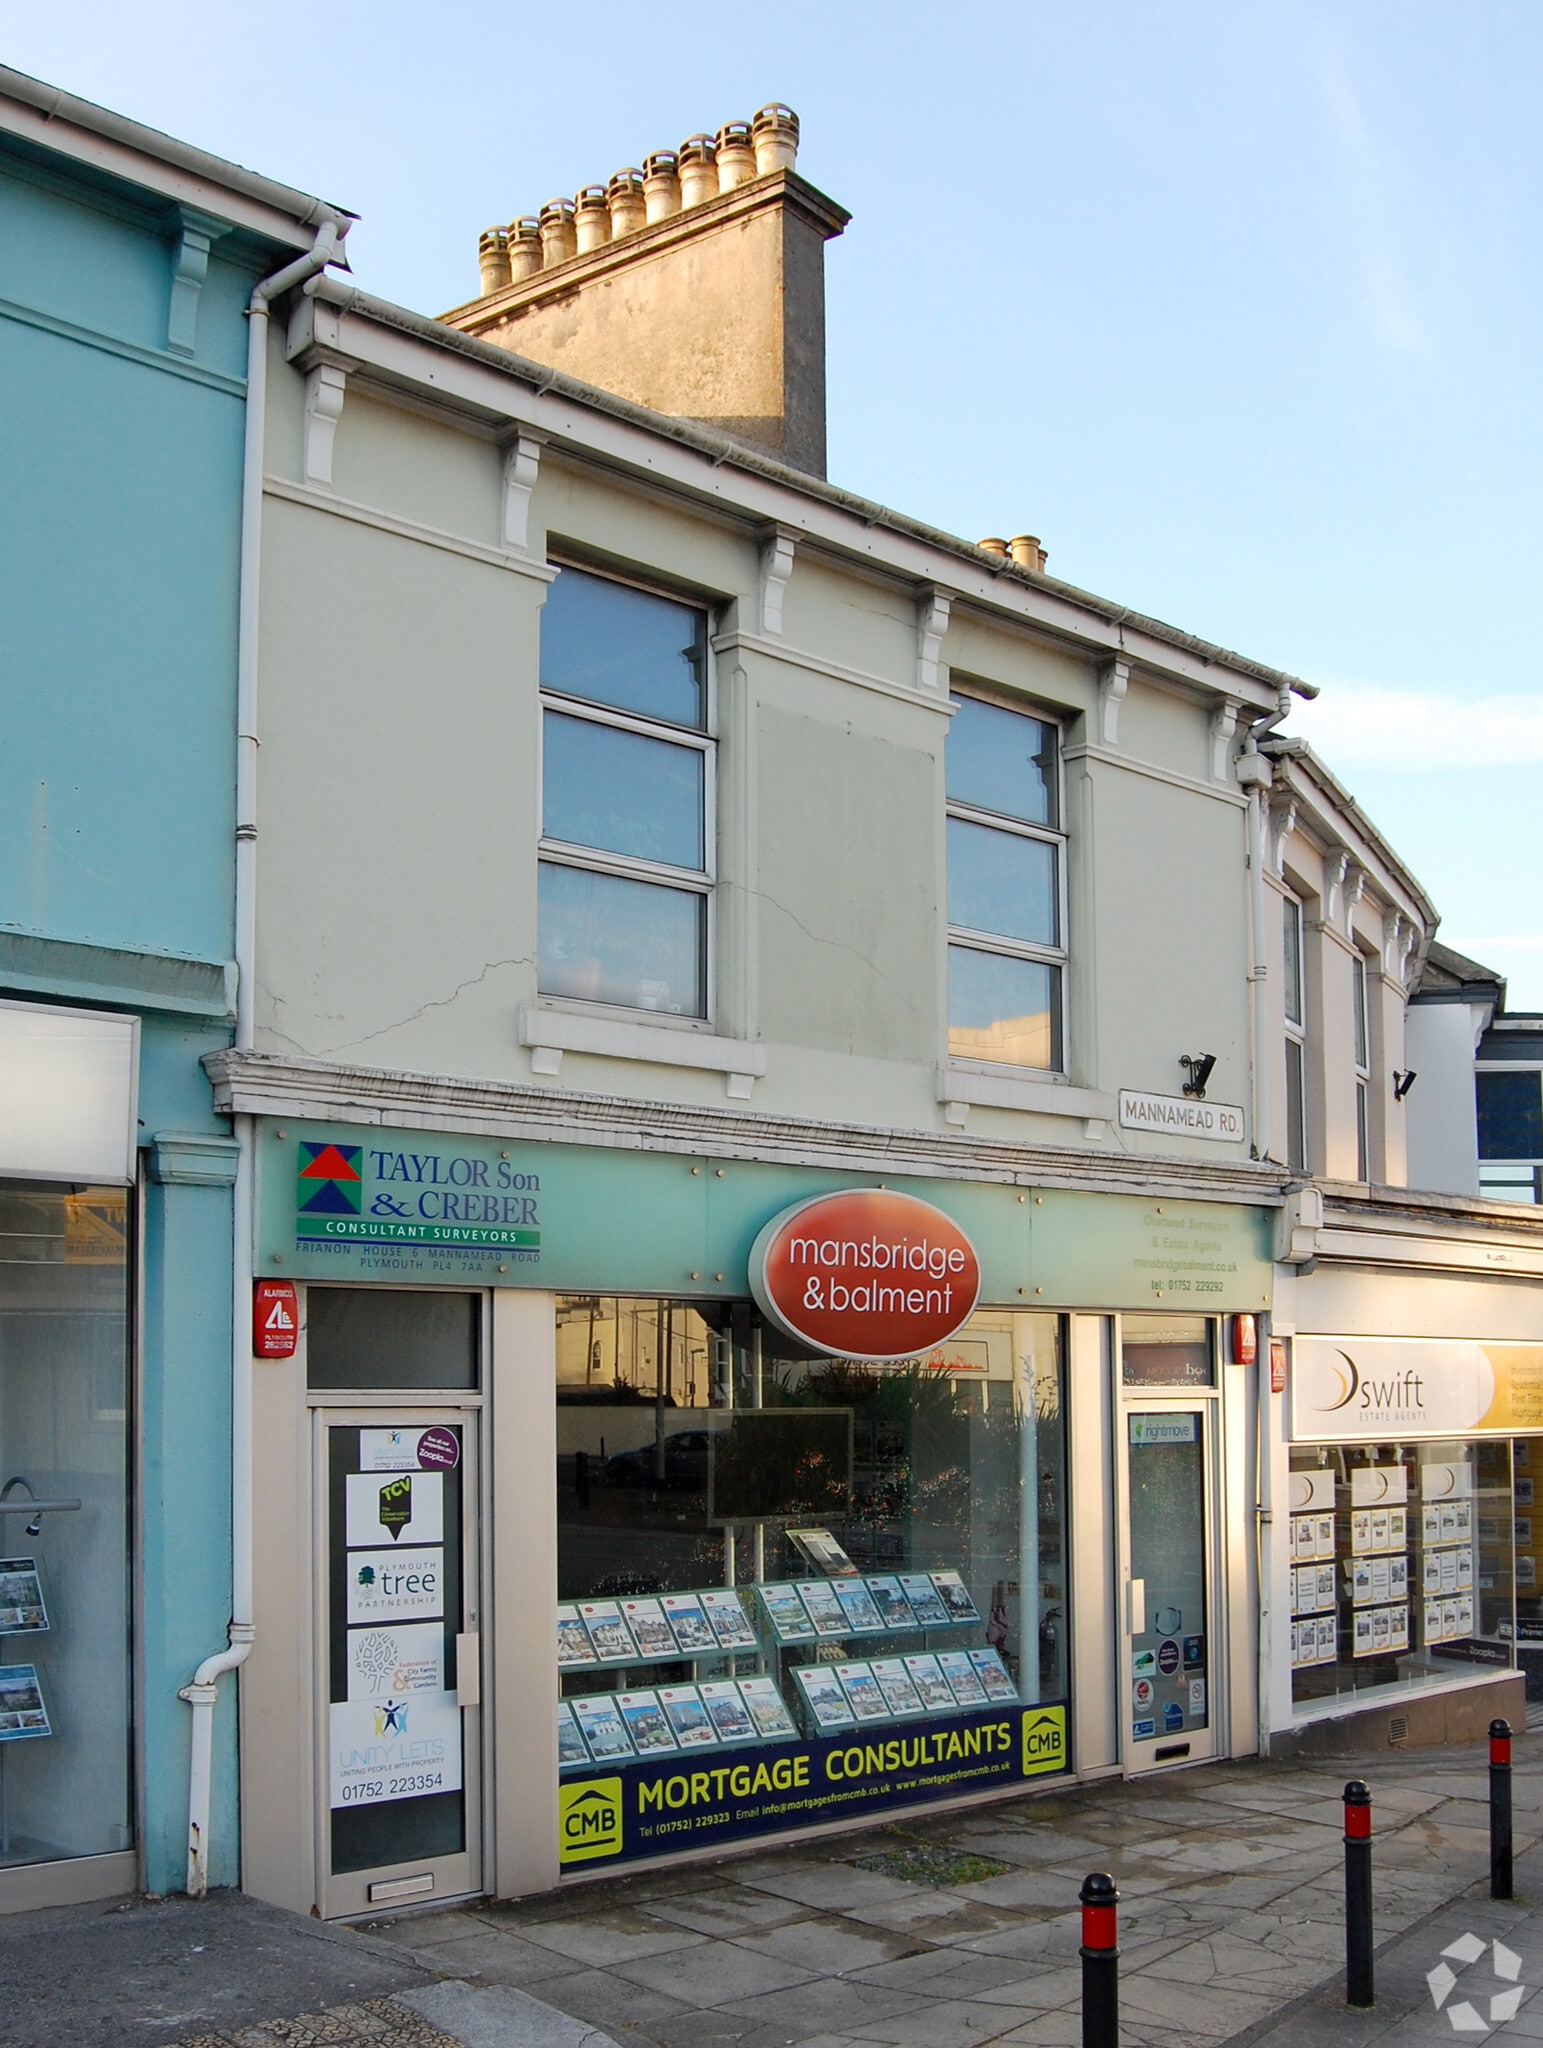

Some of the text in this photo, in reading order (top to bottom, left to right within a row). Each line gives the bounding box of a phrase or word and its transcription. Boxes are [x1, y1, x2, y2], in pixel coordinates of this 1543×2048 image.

[1125, 1099, 1214, 1129] MANNAMEAD
[369, 1150, 541, 1192] TAYLOR Son
[370, 1190, 541, 1225] & CREBER
[326, 1221, 517, 1243] CONSULTANT SURVEYORS
[296, 1242, 541, 1264] FRIANON HOUSE 6 MANNAMEAD ROAD
[790, 1235, 966, 1280] mansbridge
[360, 1258, 484, 1273] PLYMOUTH PL4 7AA
[1151, 1280, 1224, 1292] tel: 01752 229292
[1360, 1369, 1424, 1409] swift
[1359, 1410, 1427, 1422] ESTATE AGENTS
[1145, 1422, 1190, 1441] rightmove
[381, 1477, 410, 1501] TCV
[378, 1561, 437, 1572] PLYMOUTH
[381, 1573, 436, 1595] tree
[357, 1596, 436, 1608] PARTNERSHIP
[393, 1669, 410, 1691] &
[340, 1739, 445, 1768] UNITY LETS
[1027, 1730, 1063, 1755] CMB
[340, 1757, 445, 1778] UNITING PEOPLE WITH PROPERTY
[638, 1722, 1012, 1814] MORTGAGE CONSULTANTS
[342, 1772, 443, 1801] 01752 223354
[639, 1760, 1012, 1838] Tel (01752) 229323 Email info@mortgagesfromcmb.co.uk www.mortgagesfromcmb.co.uk
[565, 1808, 617, 1838] CMB
